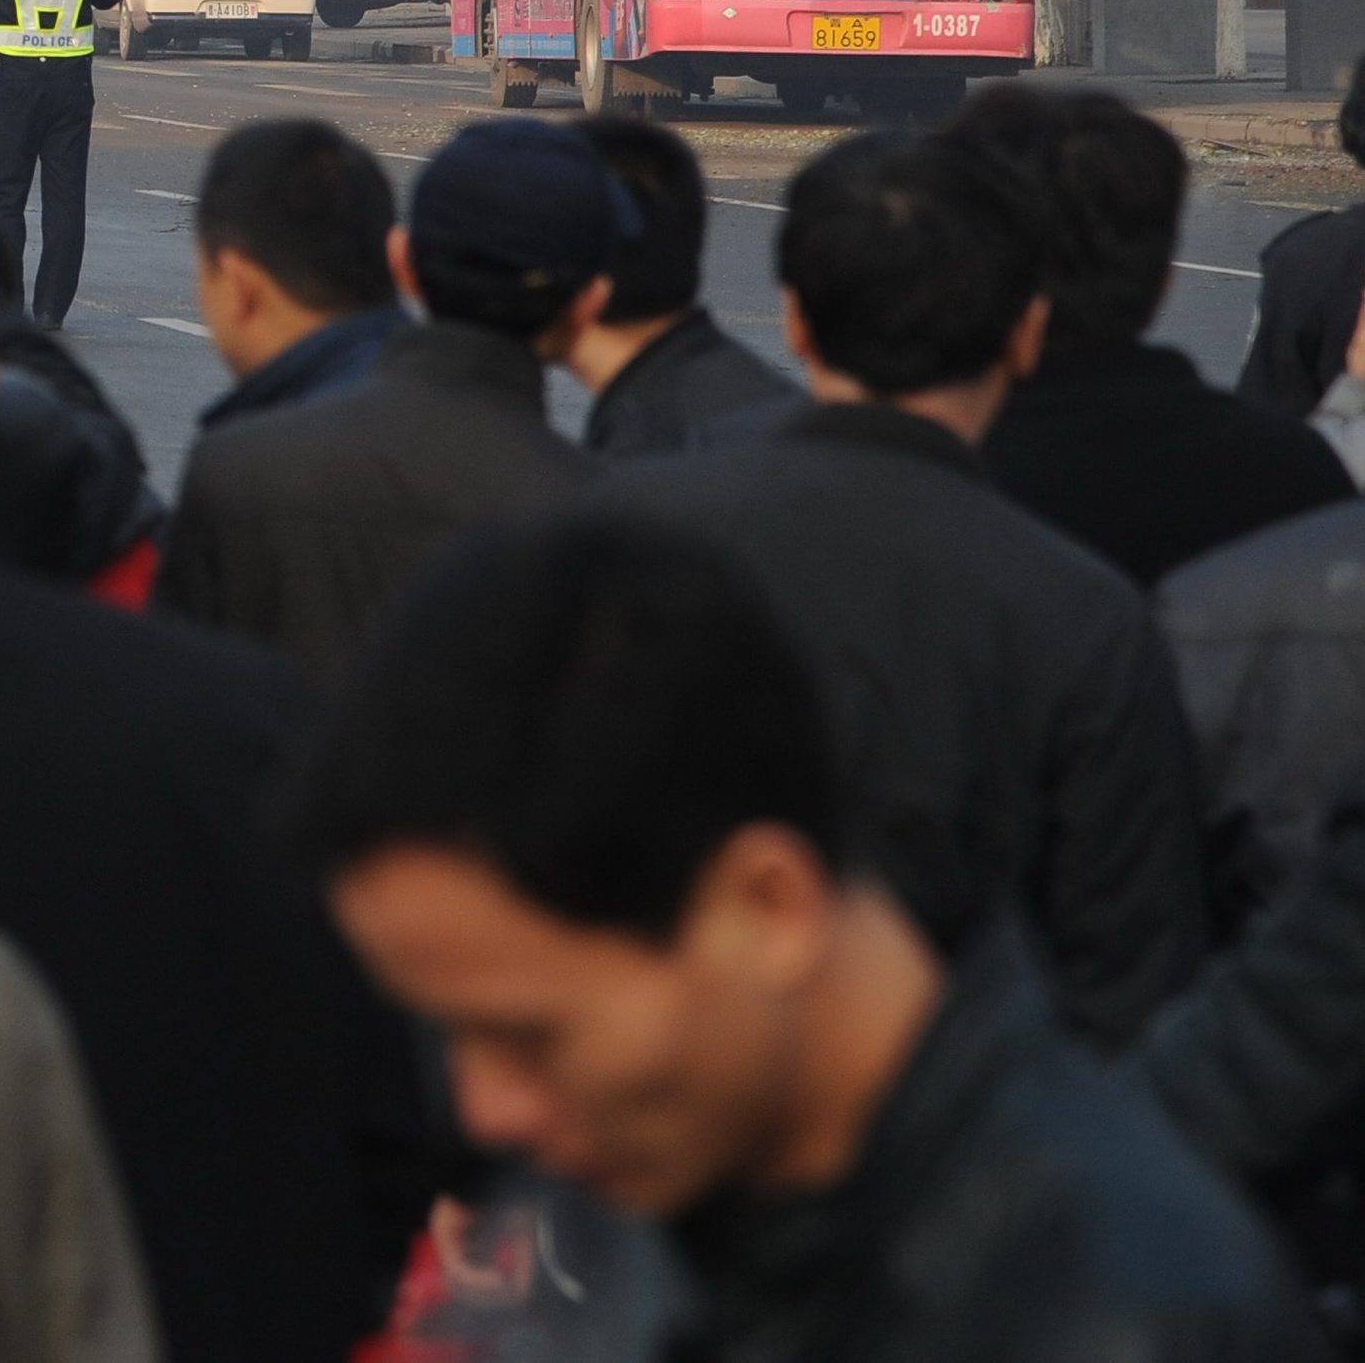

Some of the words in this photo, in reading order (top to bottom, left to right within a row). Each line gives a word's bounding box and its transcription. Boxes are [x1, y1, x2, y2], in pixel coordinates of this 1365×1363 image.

[913, 14, 981, 37] 1-0387
[21, 34, 75, 47] POLICE
[816, 29, 877, 48] 81659
